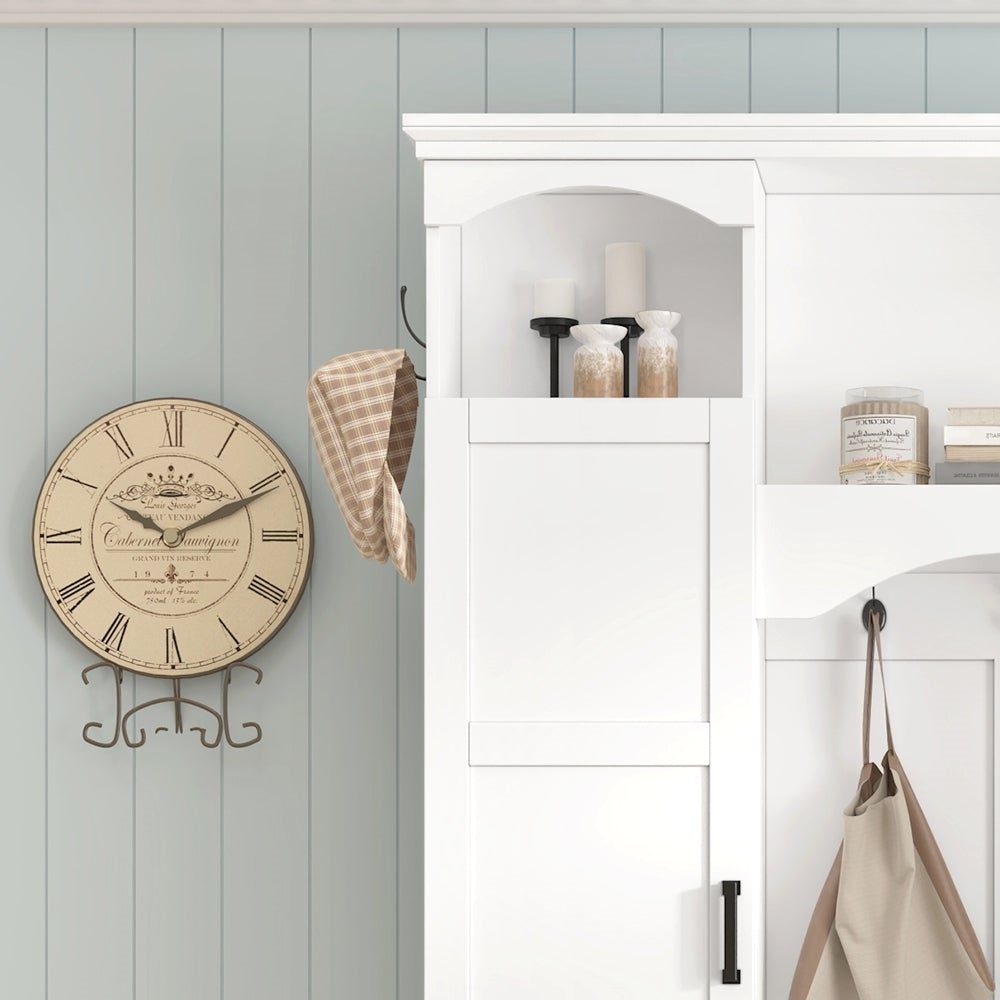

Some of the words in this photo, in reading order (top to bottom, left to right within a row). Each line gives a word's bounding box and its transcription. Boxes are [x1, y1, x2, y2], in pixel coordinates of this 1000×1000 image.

[144, 498, 166, 509] Louis
[181, 534, 240, 554] auvignon
[144, 587, 165, 595] product
[166, 587, 174, 595] of
[176, 585, 200, 595] France
